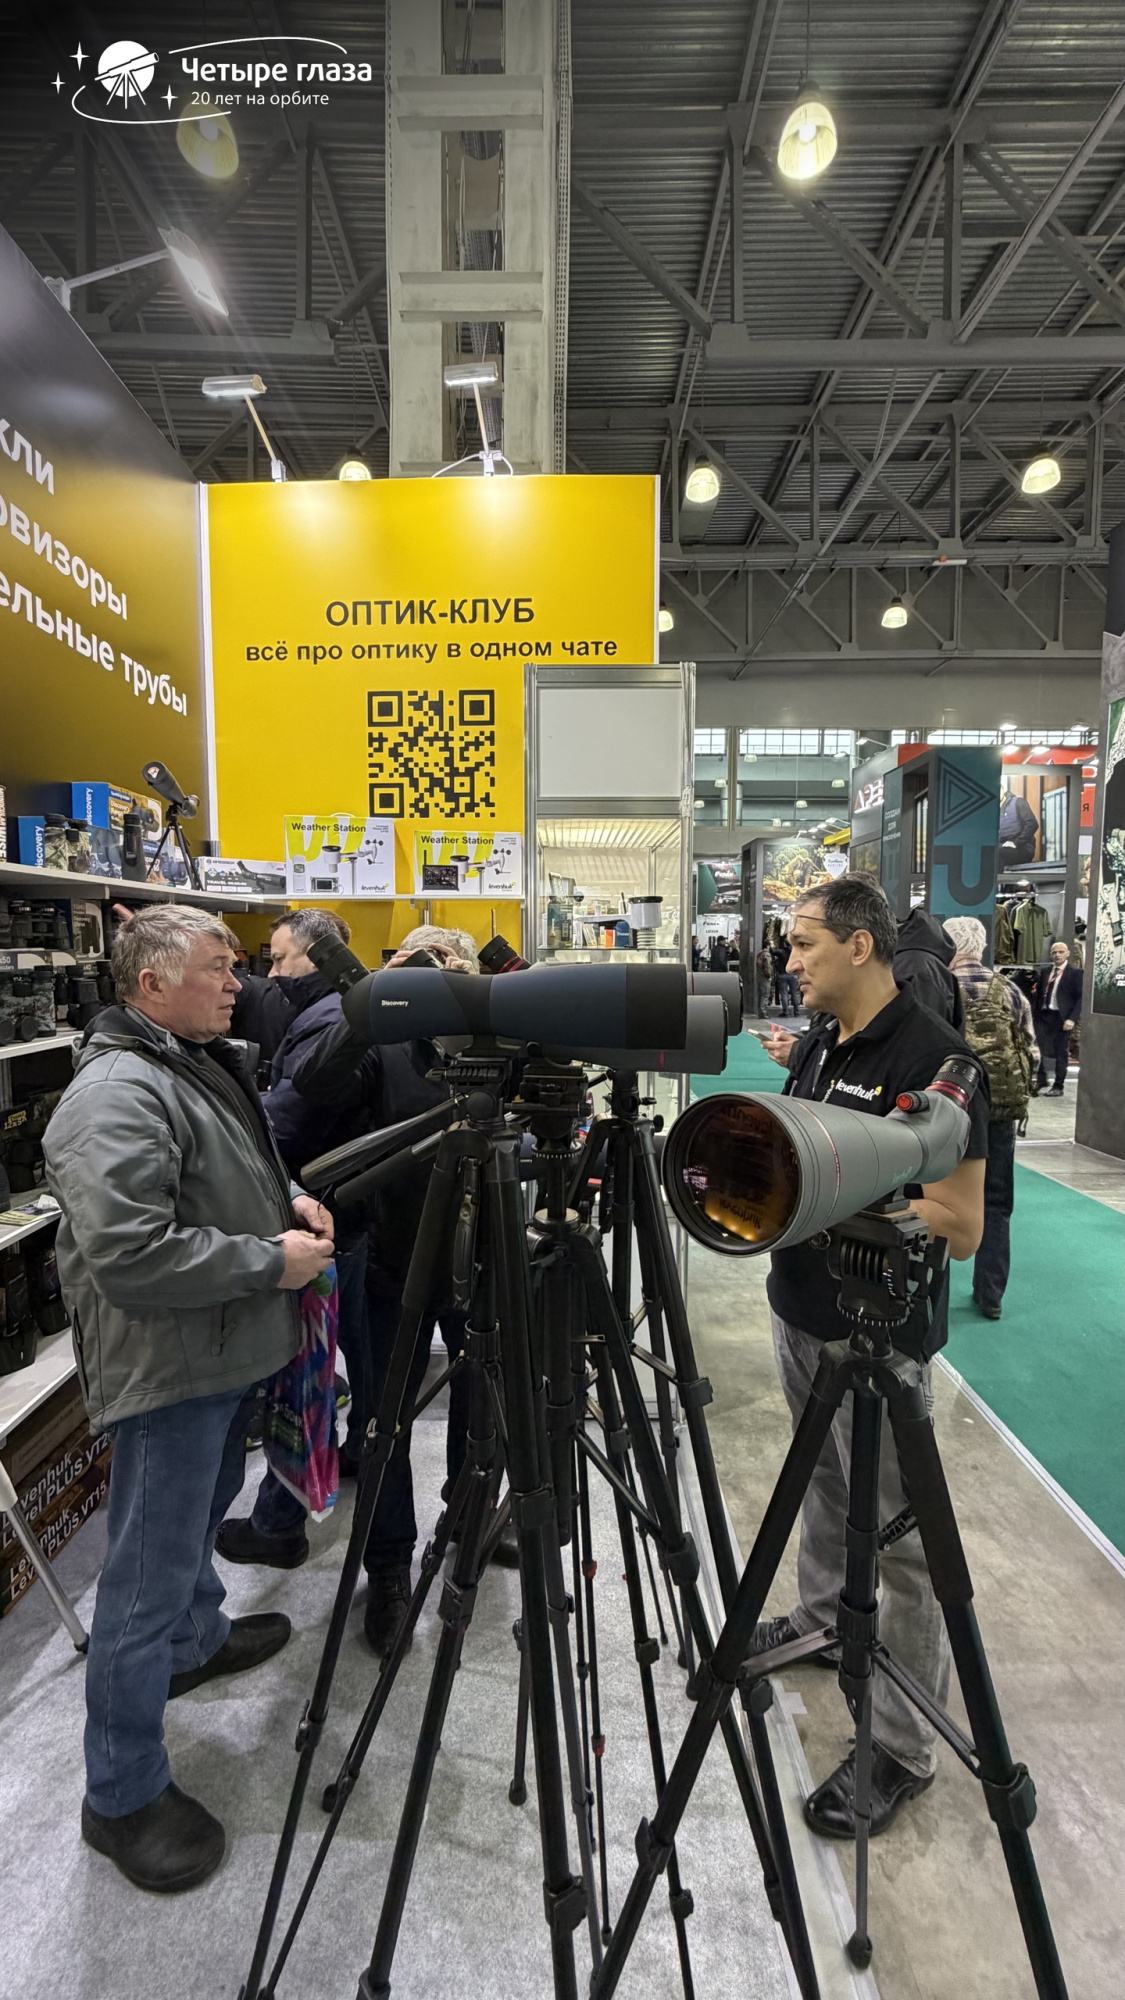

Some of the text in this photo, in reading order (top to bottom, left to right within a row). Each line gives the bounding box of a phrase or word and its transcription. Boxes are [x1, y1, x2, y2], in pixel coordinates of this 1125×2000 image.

[325, 598, 535, 627] ОПТИК-КЛУБ
[246, 640, 618, 665] всё про оптику в одном чате
[121, 652, 187, 716] трубы
[291, 822, 331, 832] Weather
[333, 823, 367, 833] Station
[420, 835, 460, 844] Weather
[461, 836, 495, 845] Station
[381, 999, 409, 1008] Discovery
[835, 1078, 877, 1101] levenhuk
[46, 1457, 84, 1505] PLUS
[48, 1511, 79, 1558] PLUS
[81, 1480, 107, 1516] VT15
